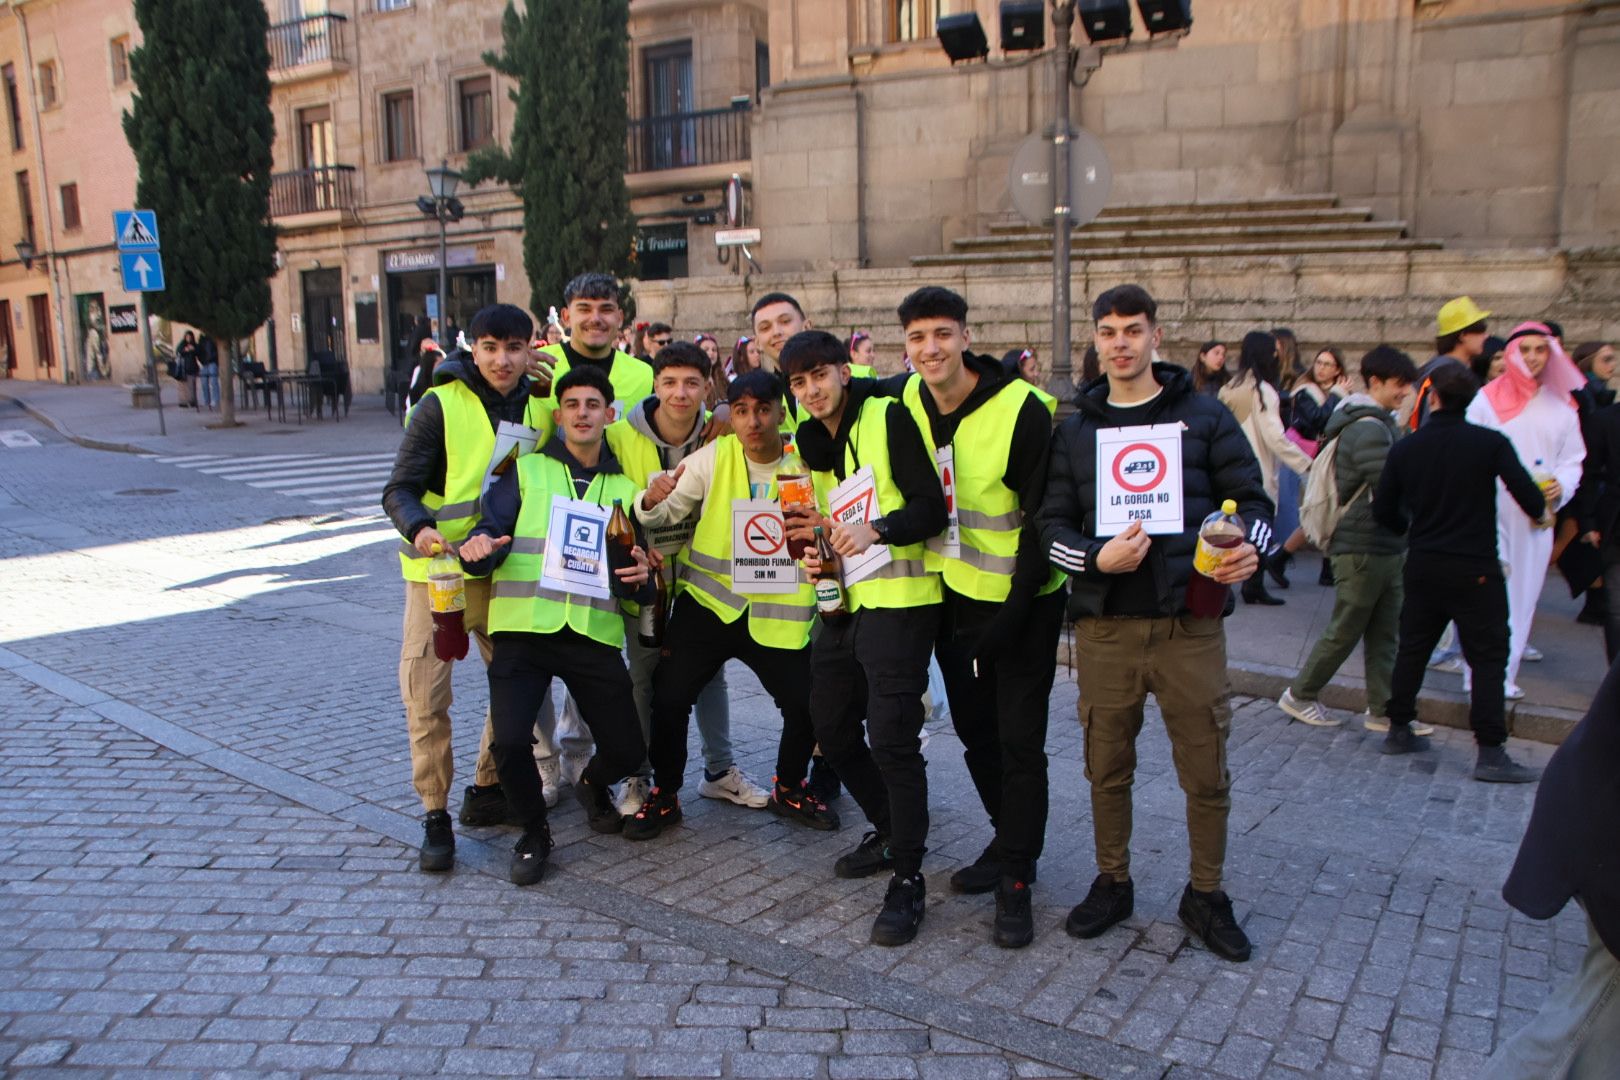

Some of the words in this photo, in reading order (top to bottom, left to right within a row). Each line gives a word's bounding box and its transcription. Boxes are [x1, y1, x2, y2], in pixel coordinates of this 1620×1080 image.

[647, 236, 686, 251] Trastero
[1111, 495, 1122, 506] LA
[1124, 493, 1154, 505] GORDA
[1157, 492, 1170, 504] NO
[842, 505, 857, 522] CEDA
[856, 501, 864, 512] EL
[1128, 509, 1152, 520] PASA
[563, 545, 600, 560] RECARGAR
[567, 559, 594, 573] CUBATA
[735, 557, 770, 567] PROHIBIDO
[754, 570, 766, 579] SIN
[767, 570, 777, 579] MI
